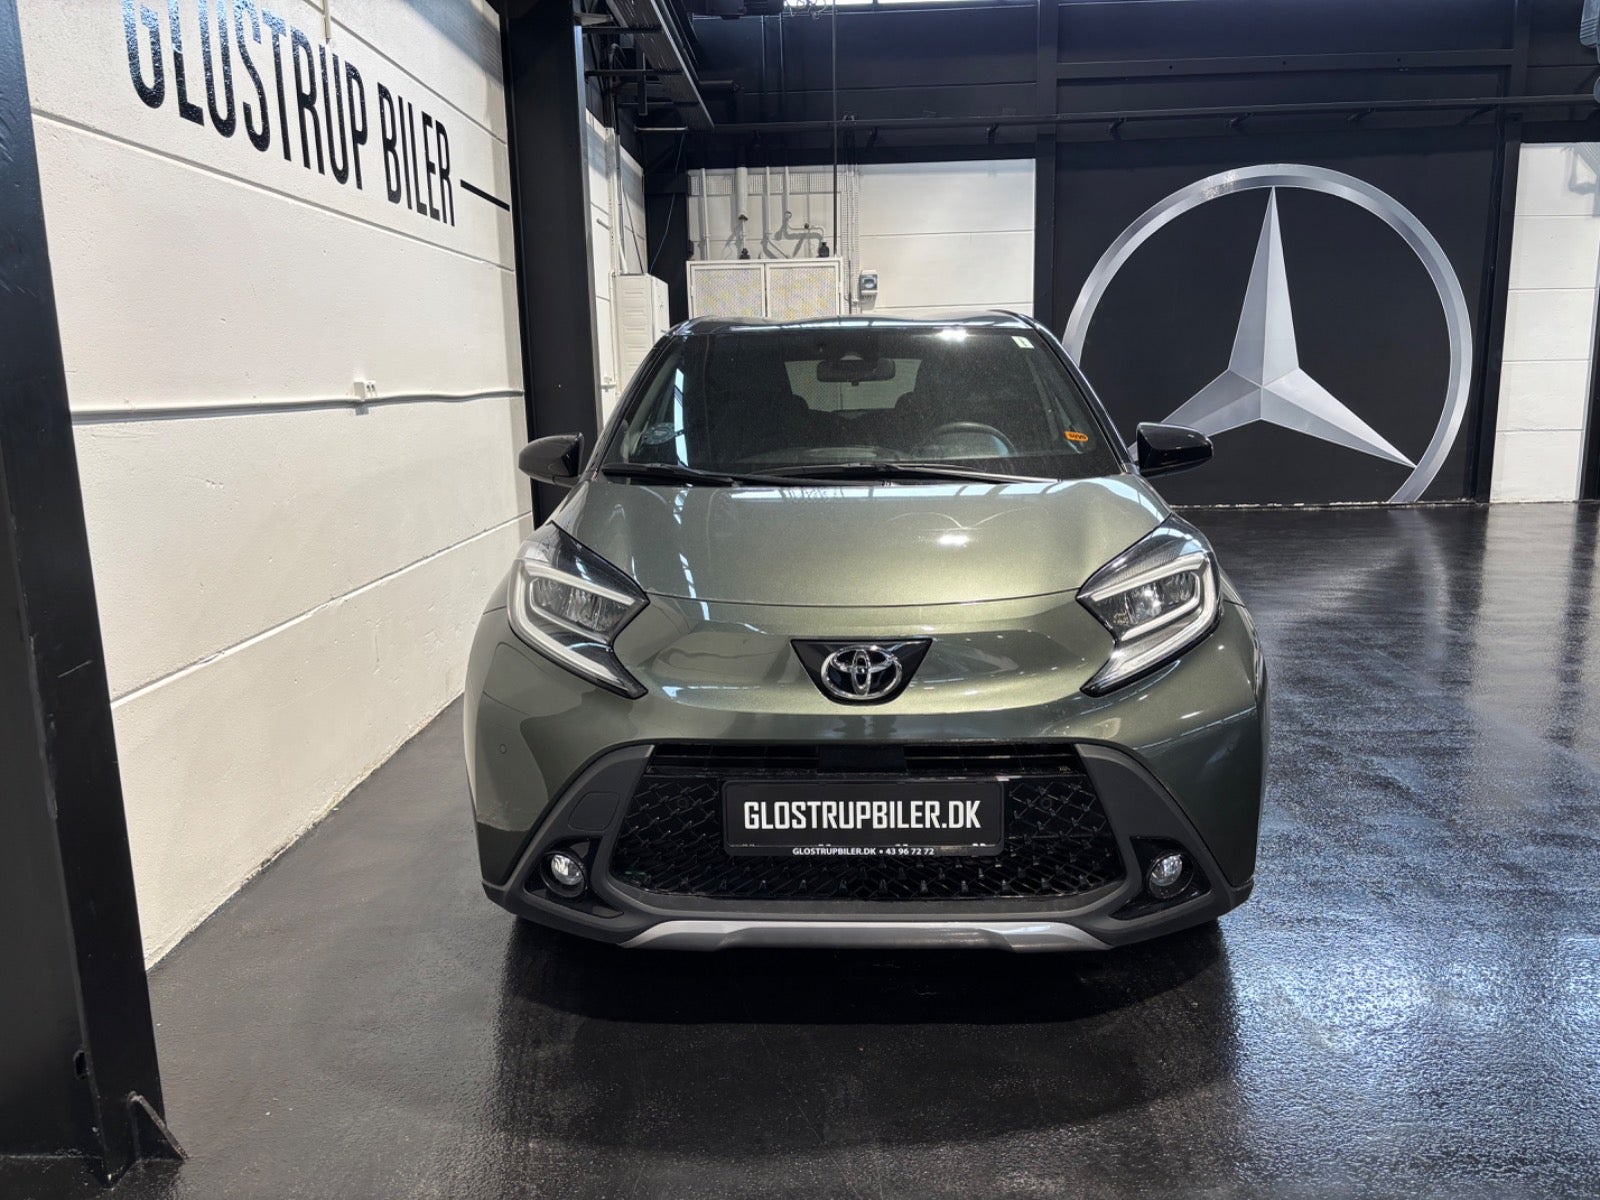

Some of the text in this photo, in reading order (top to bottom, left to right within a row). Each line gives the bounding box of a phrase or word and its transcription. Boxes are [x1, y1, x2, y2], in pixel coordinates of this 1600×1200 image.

[122, 0, 456, 227] GLOSTRUP BILER
[743, 800, 982, 830] GLOSTRUPBILER.DK
[792, 847, 935, 856] GLOSTRUPBILER.DK 43 96 72 72
